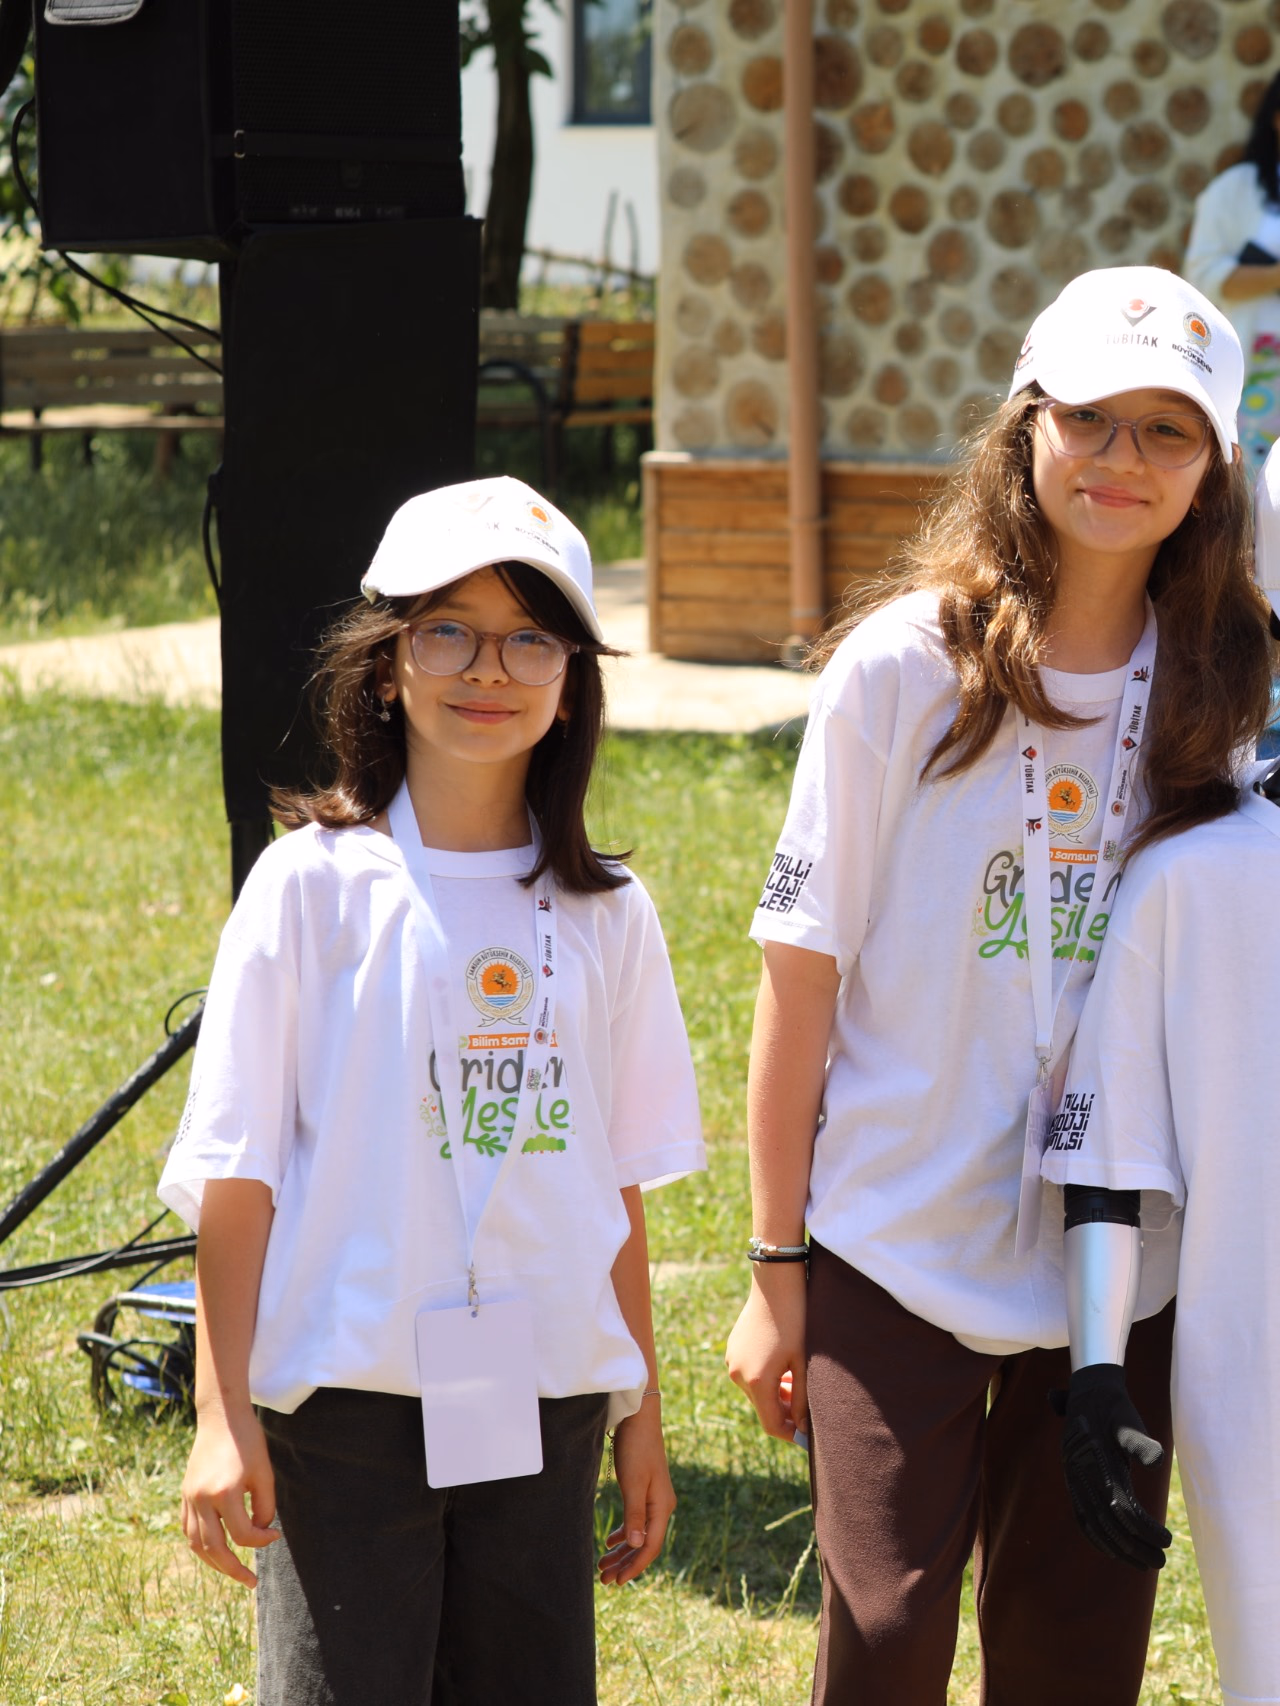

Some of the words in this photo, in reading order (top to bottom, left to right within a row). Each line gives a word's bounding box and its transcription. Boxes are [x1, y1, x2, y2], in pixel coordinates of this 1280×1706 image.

[1128, 705, 1142, 734] TÜBİTAK
[1024, 764, 1035, 794] TÜBİTAK
[1055, 850, 1099, 861] Samsun
[472, 1036, 499, 1047] Bilim
